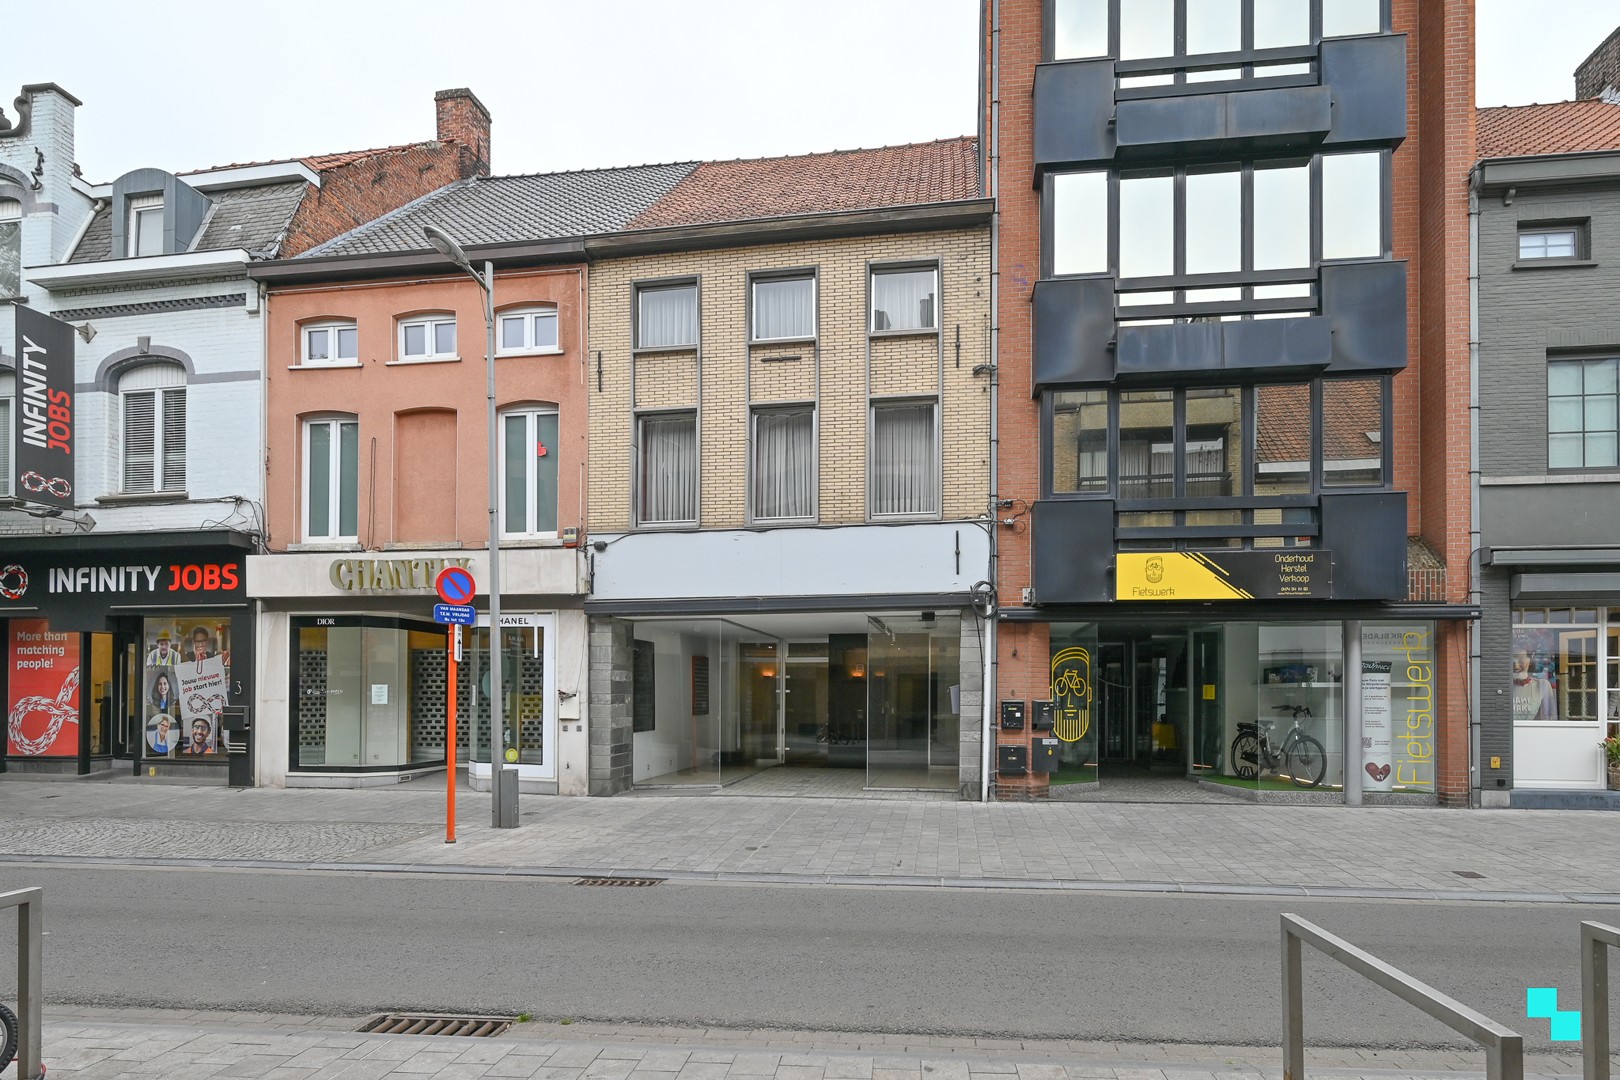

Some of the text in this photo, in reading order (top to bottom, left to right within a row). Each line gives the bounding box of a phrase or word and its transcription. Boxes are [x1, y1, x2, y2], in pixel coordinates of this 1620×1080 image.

[23, 335, 47, 448] INFINITY
[48, 388, 71, 454] JOBS
[1274, 554, 1314, 563] Onderhoud
[329, 558, 475, 591] CHANT
[1281, 564, 1307, 573] Herstel
[49, 563, 239, 593] INFINITY JOBS
[1279, 574, 1310, 584] Verkoop
[1132, 586, 1176, 597] Fietswerk
[317, 618, 336, 626] DIOR
[499, 617, 529, 625] HANEL
[17, 632, 67, 641] More than
[17, 645, 65, 657] matching
[17, 658, 53, 670] people!
[182, 673, 220, 686] Jouw nieuwe
[182, 679, 222, 695] job start hier!
[235, 680, 242, 695] 3
[1392, 631, 1433, 785] Fietswerk
